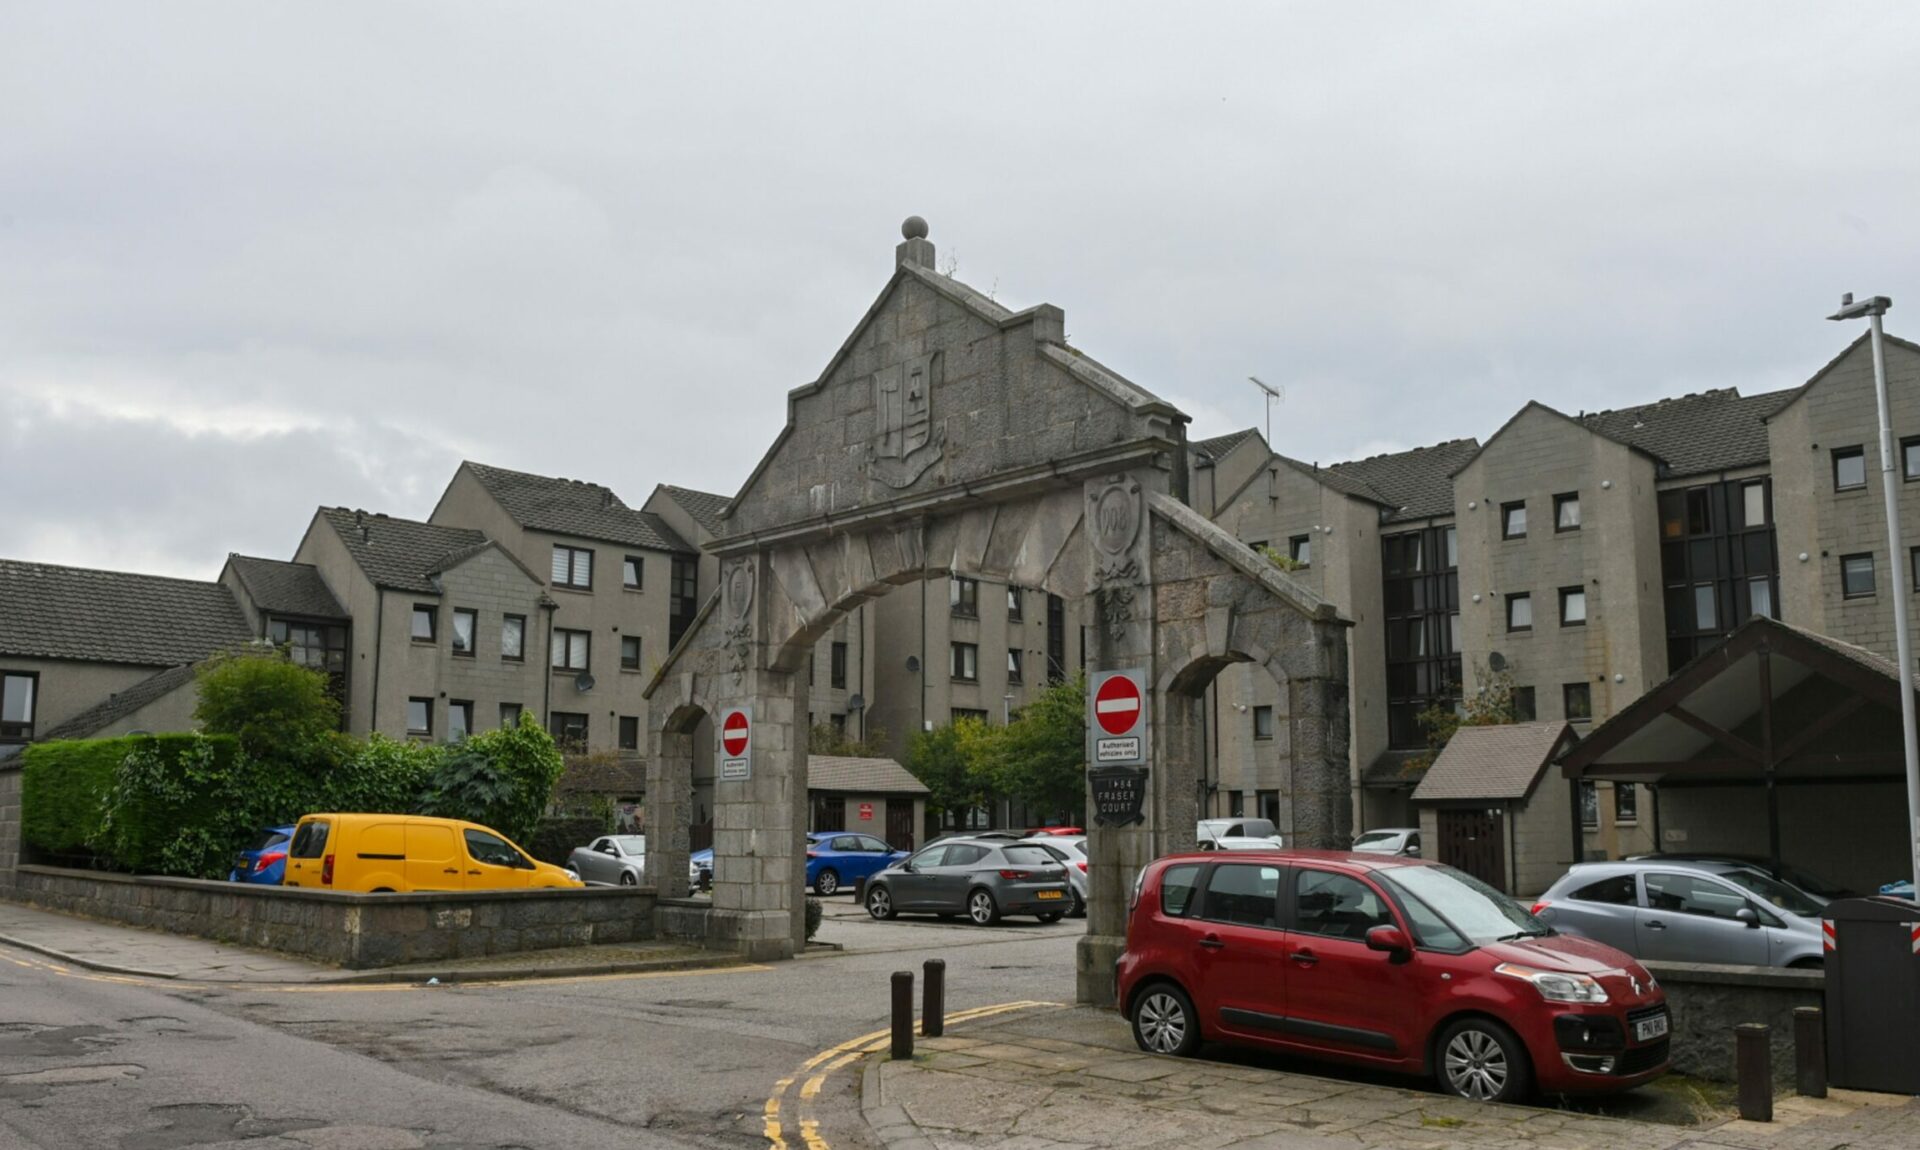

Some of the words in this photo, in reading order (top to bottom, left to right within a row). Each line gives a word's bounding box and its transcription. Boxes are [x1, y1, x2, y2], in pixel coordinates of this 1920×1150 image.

[1102, 741, 1135, 749] Authorised
[1098, 791, 1135, 800] FRASER
[1101, 803, 1131, 813] COURT
